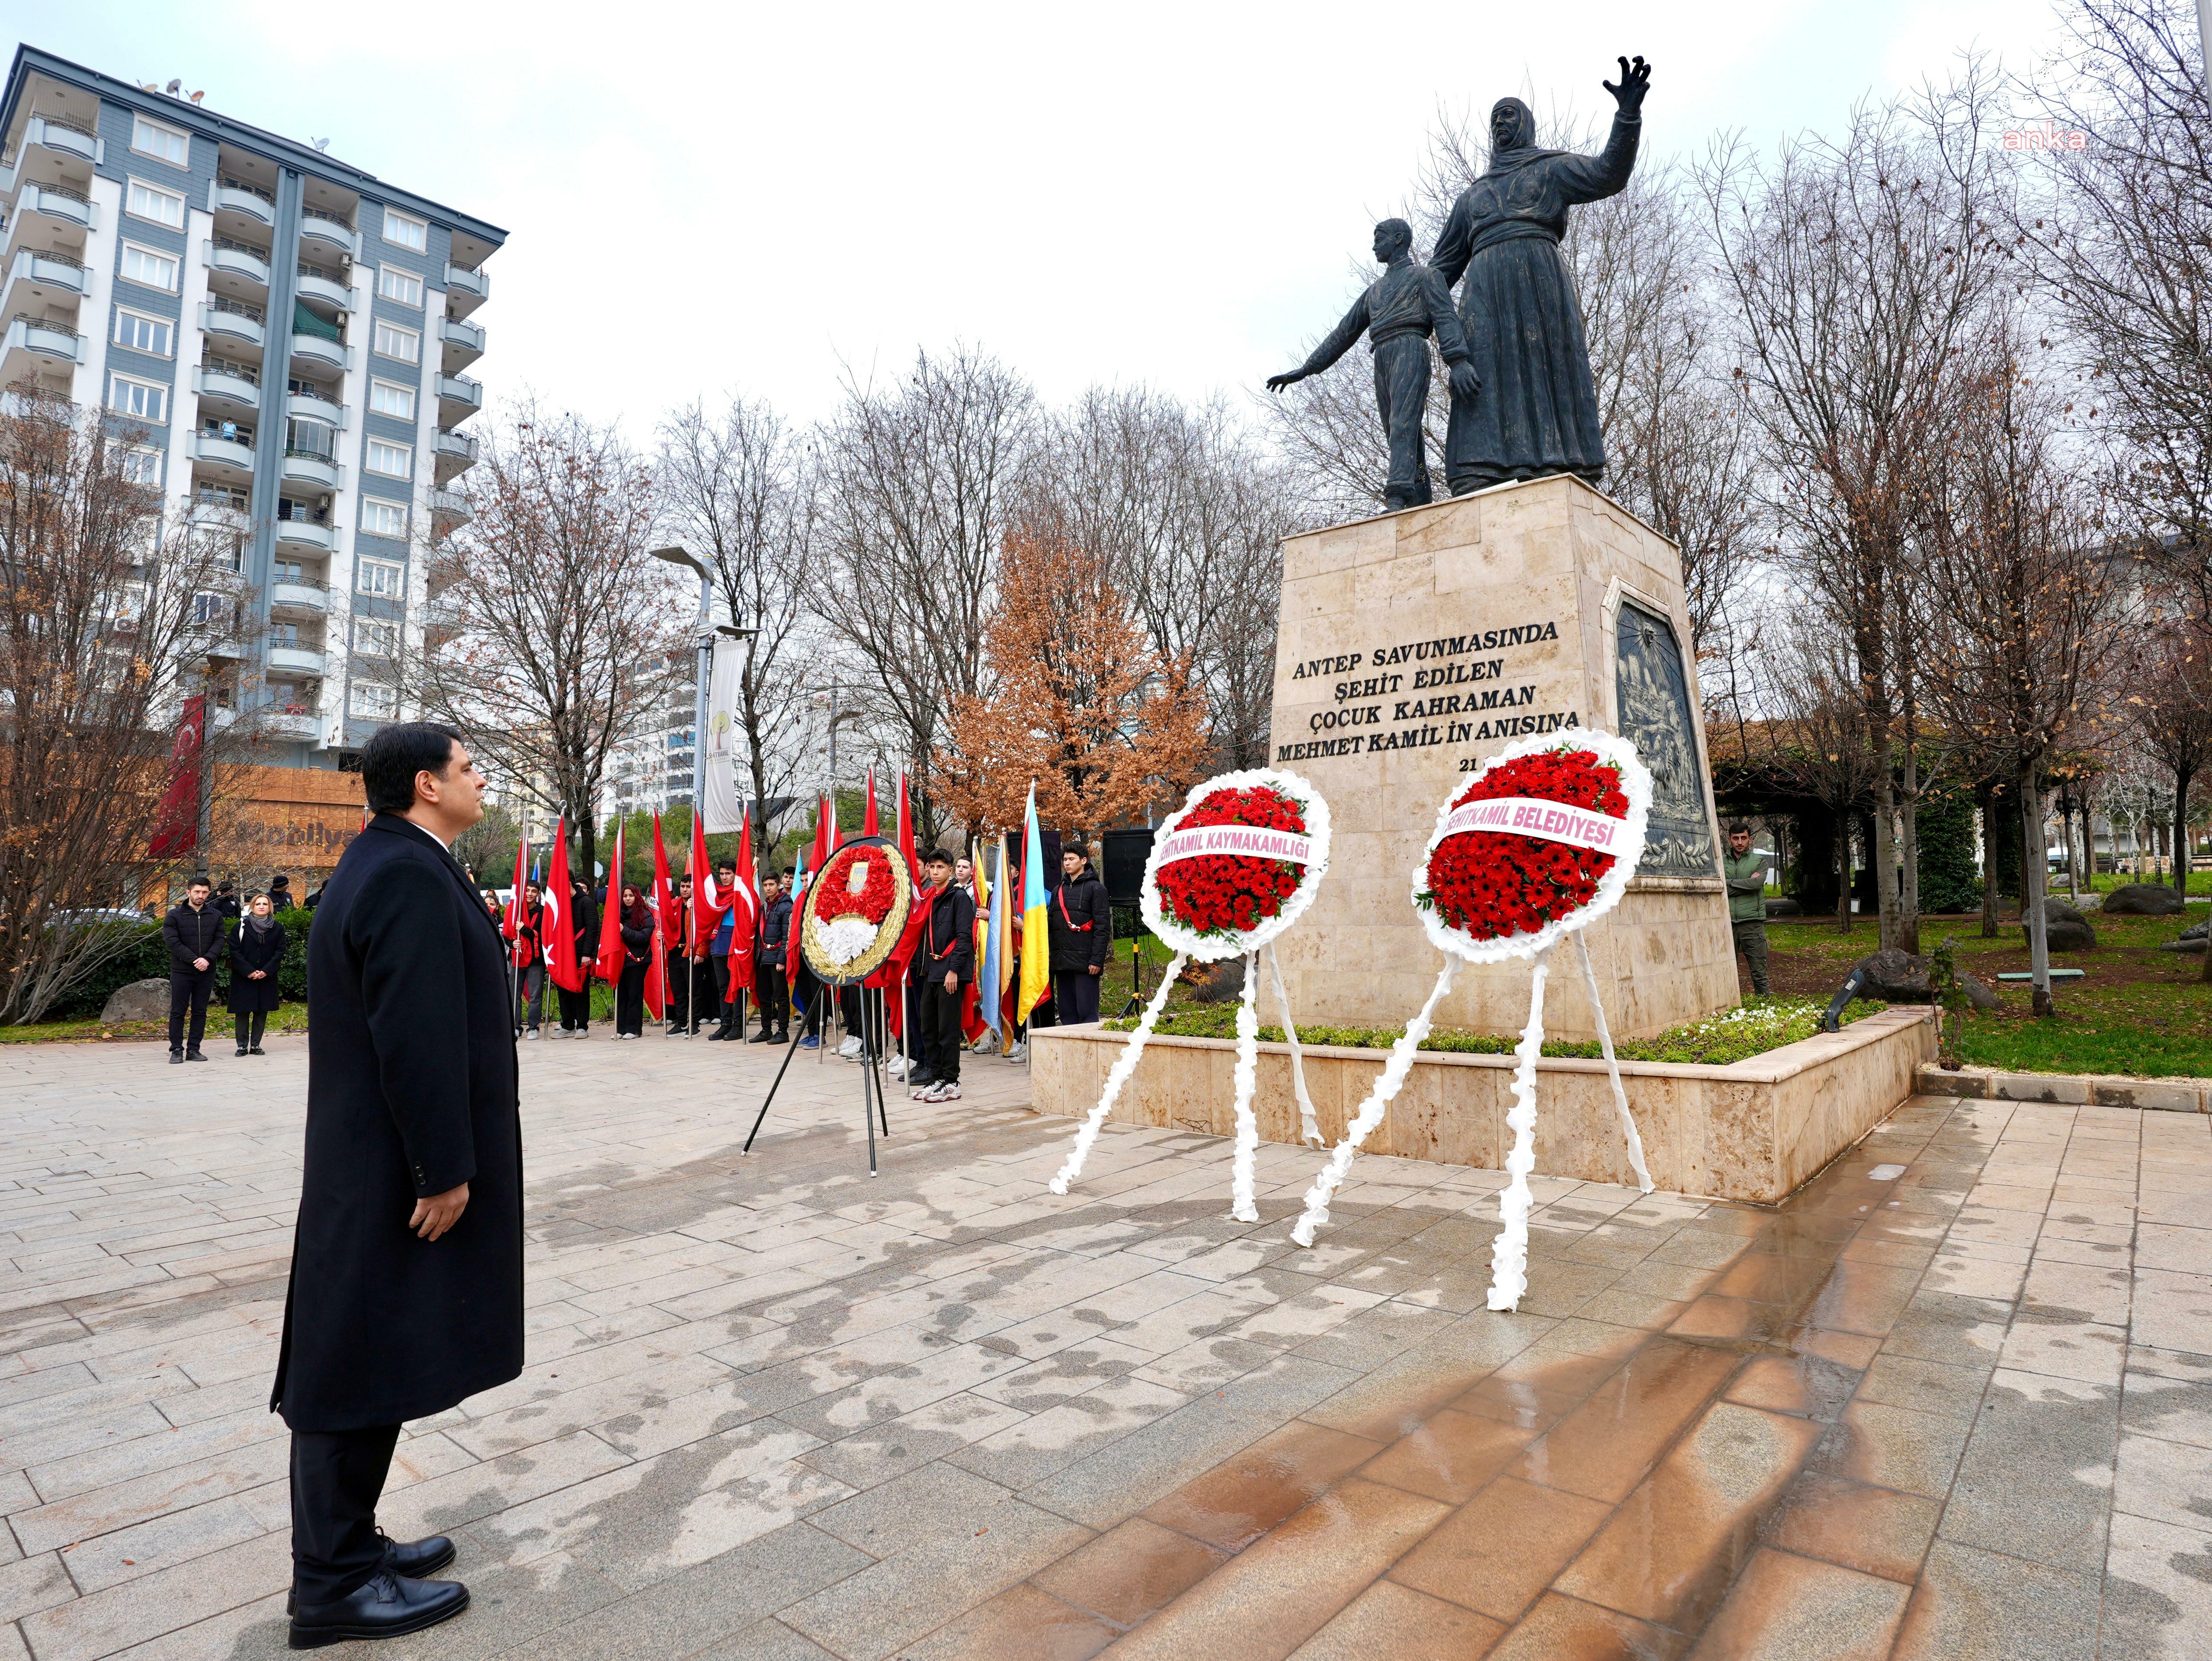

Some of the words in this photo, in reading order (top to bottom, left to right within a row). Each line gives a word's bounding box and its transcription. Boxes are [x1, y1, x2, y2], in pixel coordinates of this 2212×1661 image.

[1293, 653, 1362, 679] ANTEP
[1372, 621, 1558, 666] SAVUNMASINDA
[1335, 672, 1403, 704] ŞEHİT
[1413, 659, 1504, 689] EDİLEN
[1310, 706, 1382, 735] ÇOCUK
[1393, 686, 1536, 721] KAHRAMAN
[1277, 736, 1365, 762] MEHMET
[1475, 711, 1579, 740] ANISINA
[1459, 758, 1477, 772] 21
[1159, 830, 1203, 862] EHİTKAMİL
[1206, 832, 1309, 859] KAYMAKAMLIĞI
[1512, 806, 1616, 846] BELEDİYESİ
